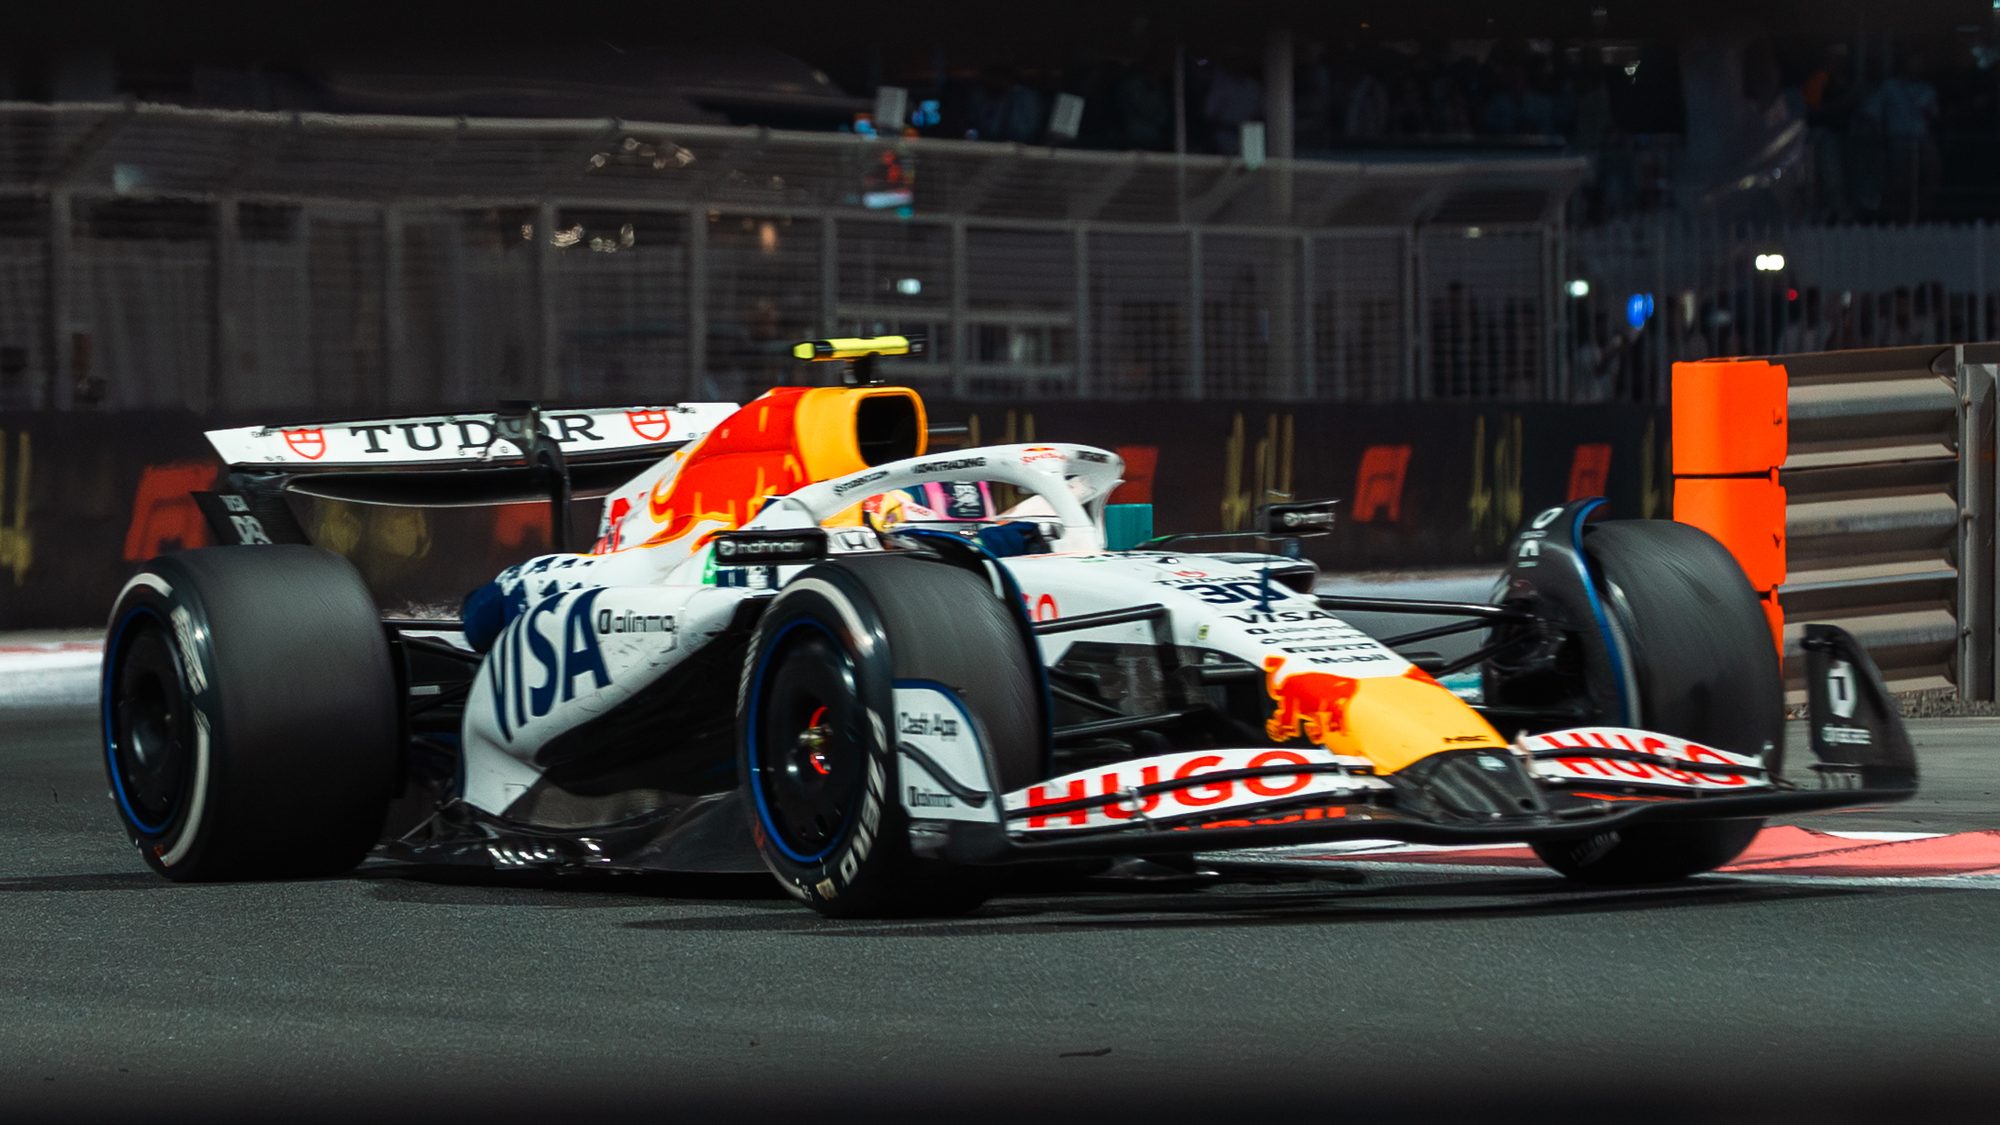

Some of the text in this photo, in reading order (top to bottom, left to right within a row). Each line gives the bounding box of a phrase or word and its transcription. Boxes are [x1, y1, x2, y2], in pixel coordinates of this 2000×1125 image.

[350, 412, 605, 459] TUDR
[1177, 581, 1290, 605] 30
[1222, 610, 1338, 624] VISA
[486, 586, 613, 744] VISA
[1540, 732, 1748, 786] HUGO
[1026, 750, 1315, 828] HUGO
